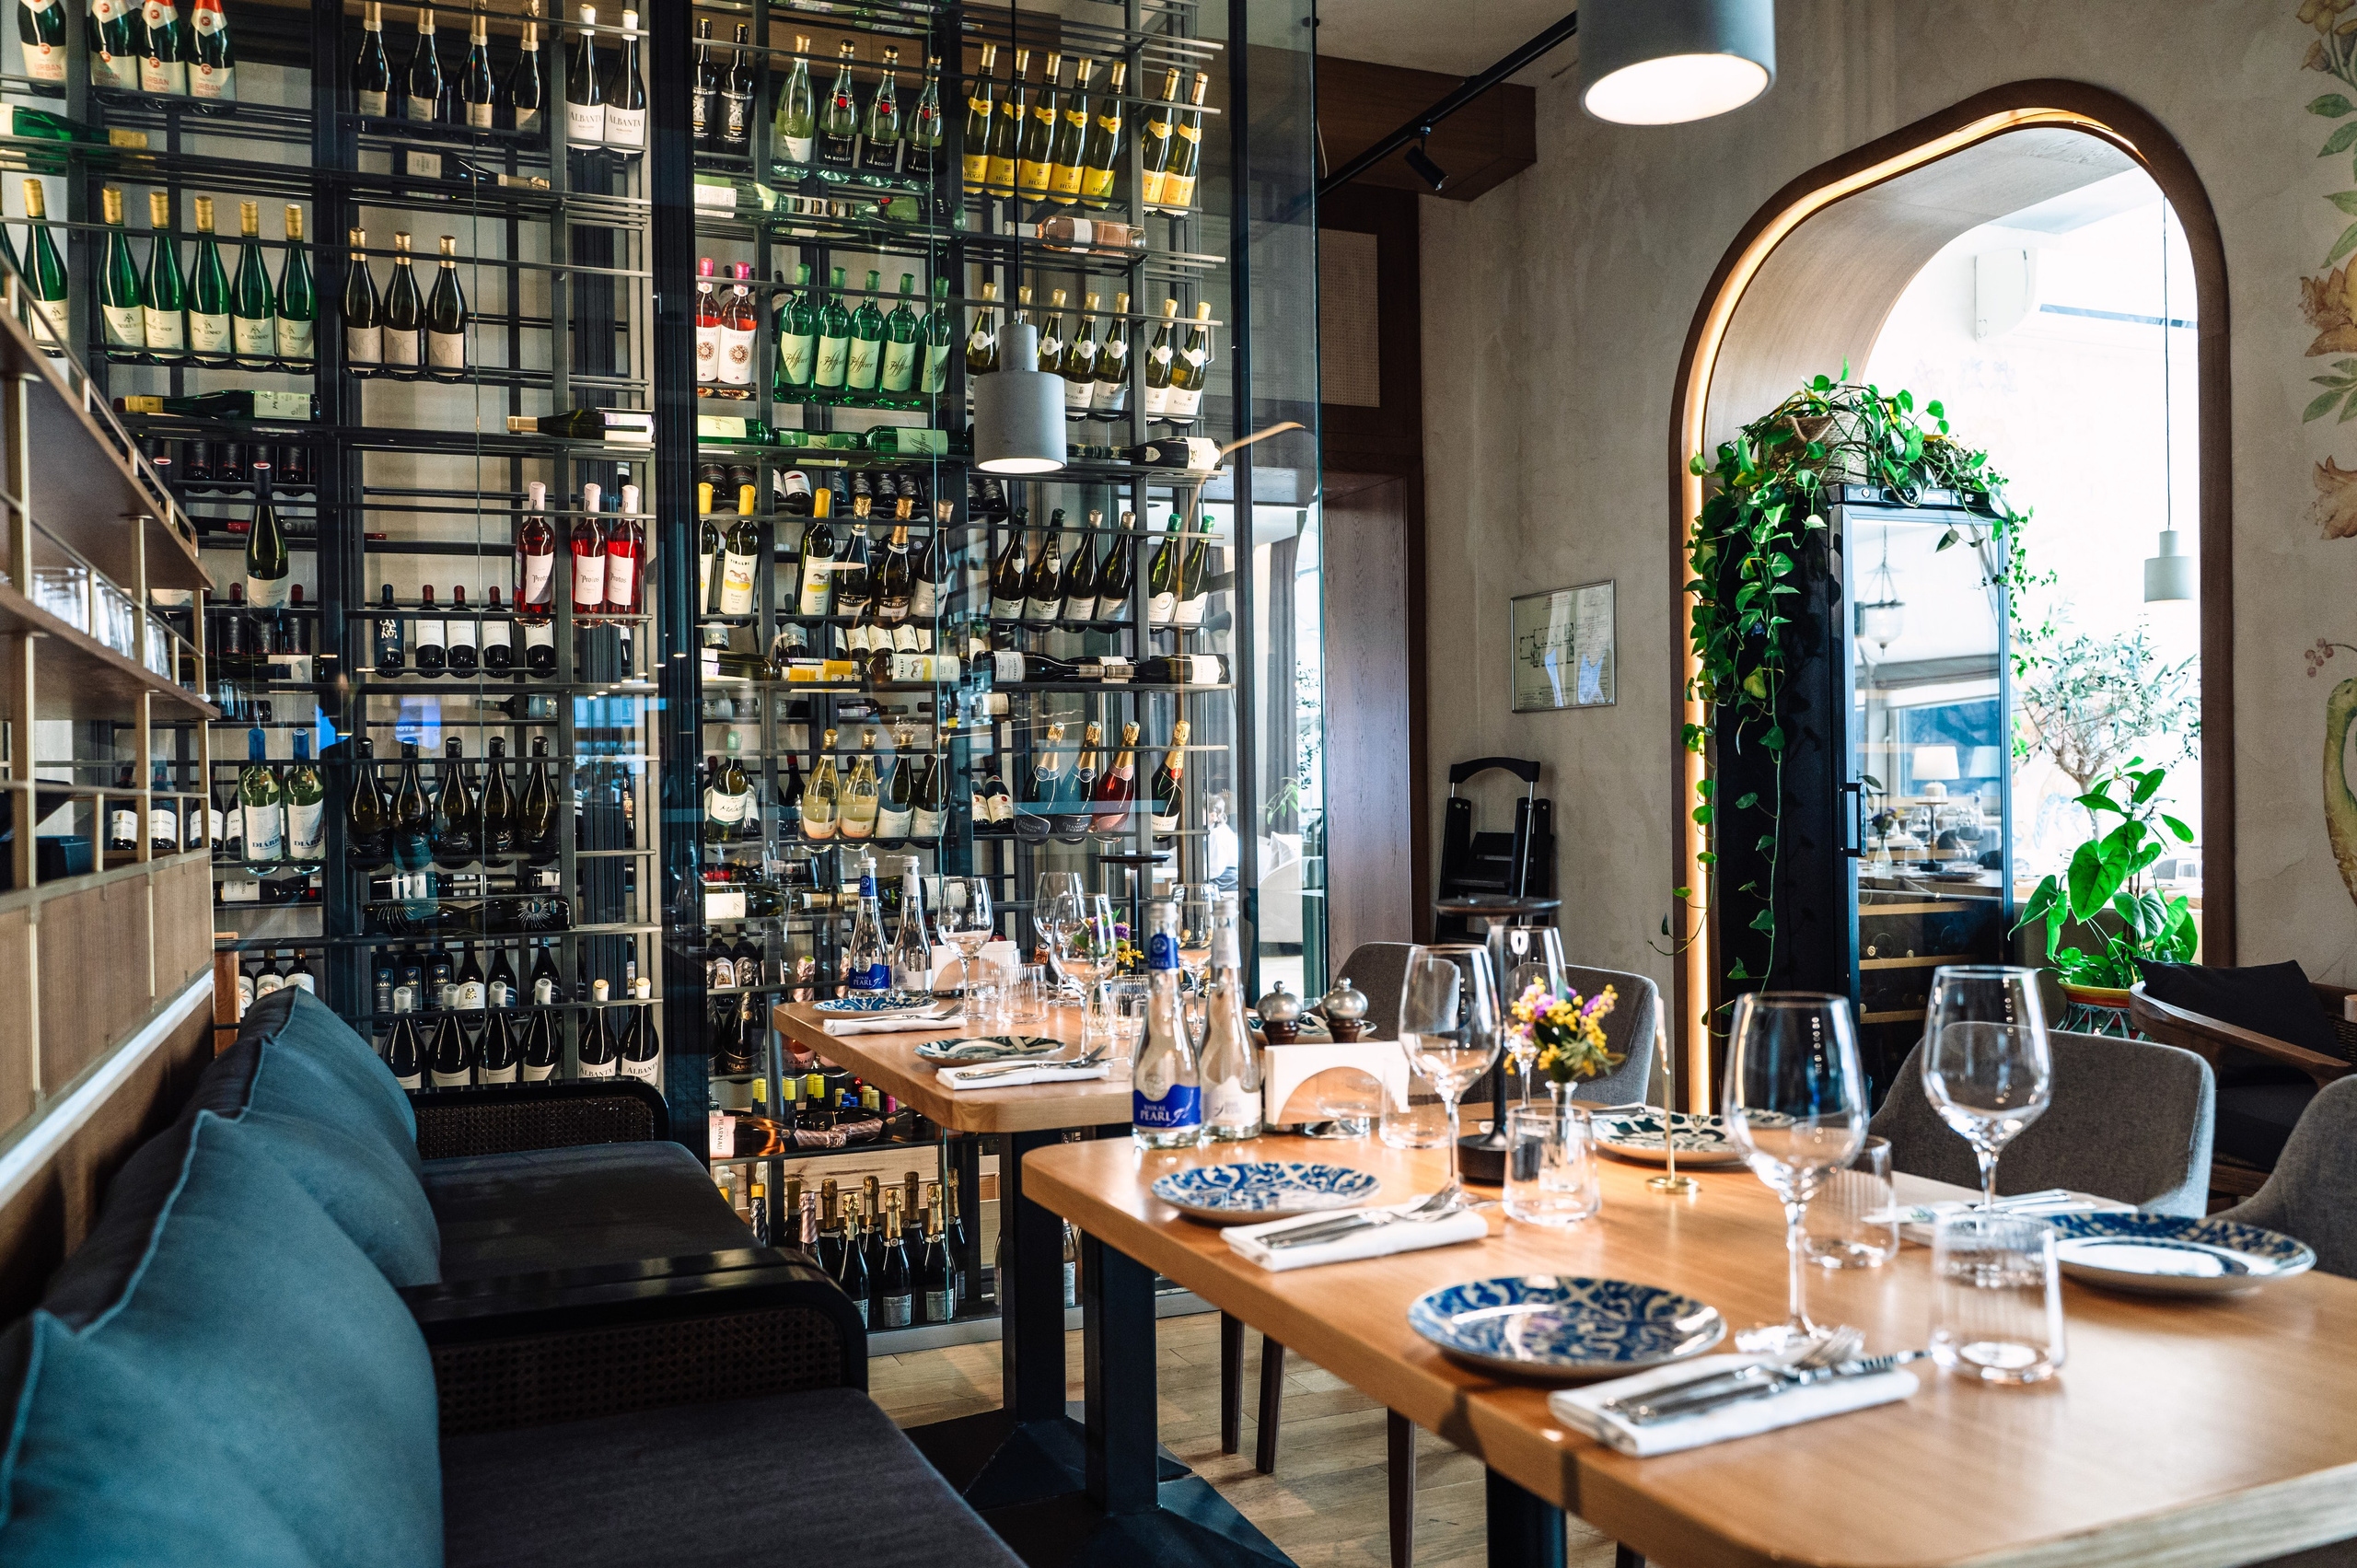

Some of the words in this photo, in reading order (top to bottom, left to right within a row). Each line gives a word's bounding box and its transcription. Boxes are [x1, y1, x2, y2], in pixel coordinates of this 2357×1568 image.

[34, 63, 63, 71] URBAN
[145, 75, 169, 86] URBAN
[195, 82, 221, 91] URBAN
[570, 110, 602, 122] ALBANTA
[609, 113, 642, 127] ALBANTA
[729, 332, 750, 341] BREZZA
[532, 574, 549, 584] Proto
[580, 574, 599, 584] Protos
[610, 572, 627, 583] Protos
[839, 596, 865, 605] PERLINO
[579, 1065, 613, 1078] ALBANTA
[626, 1061, 658, 1074] ALBANTA
[1140, 1109, 1171, 1121] PEARL
